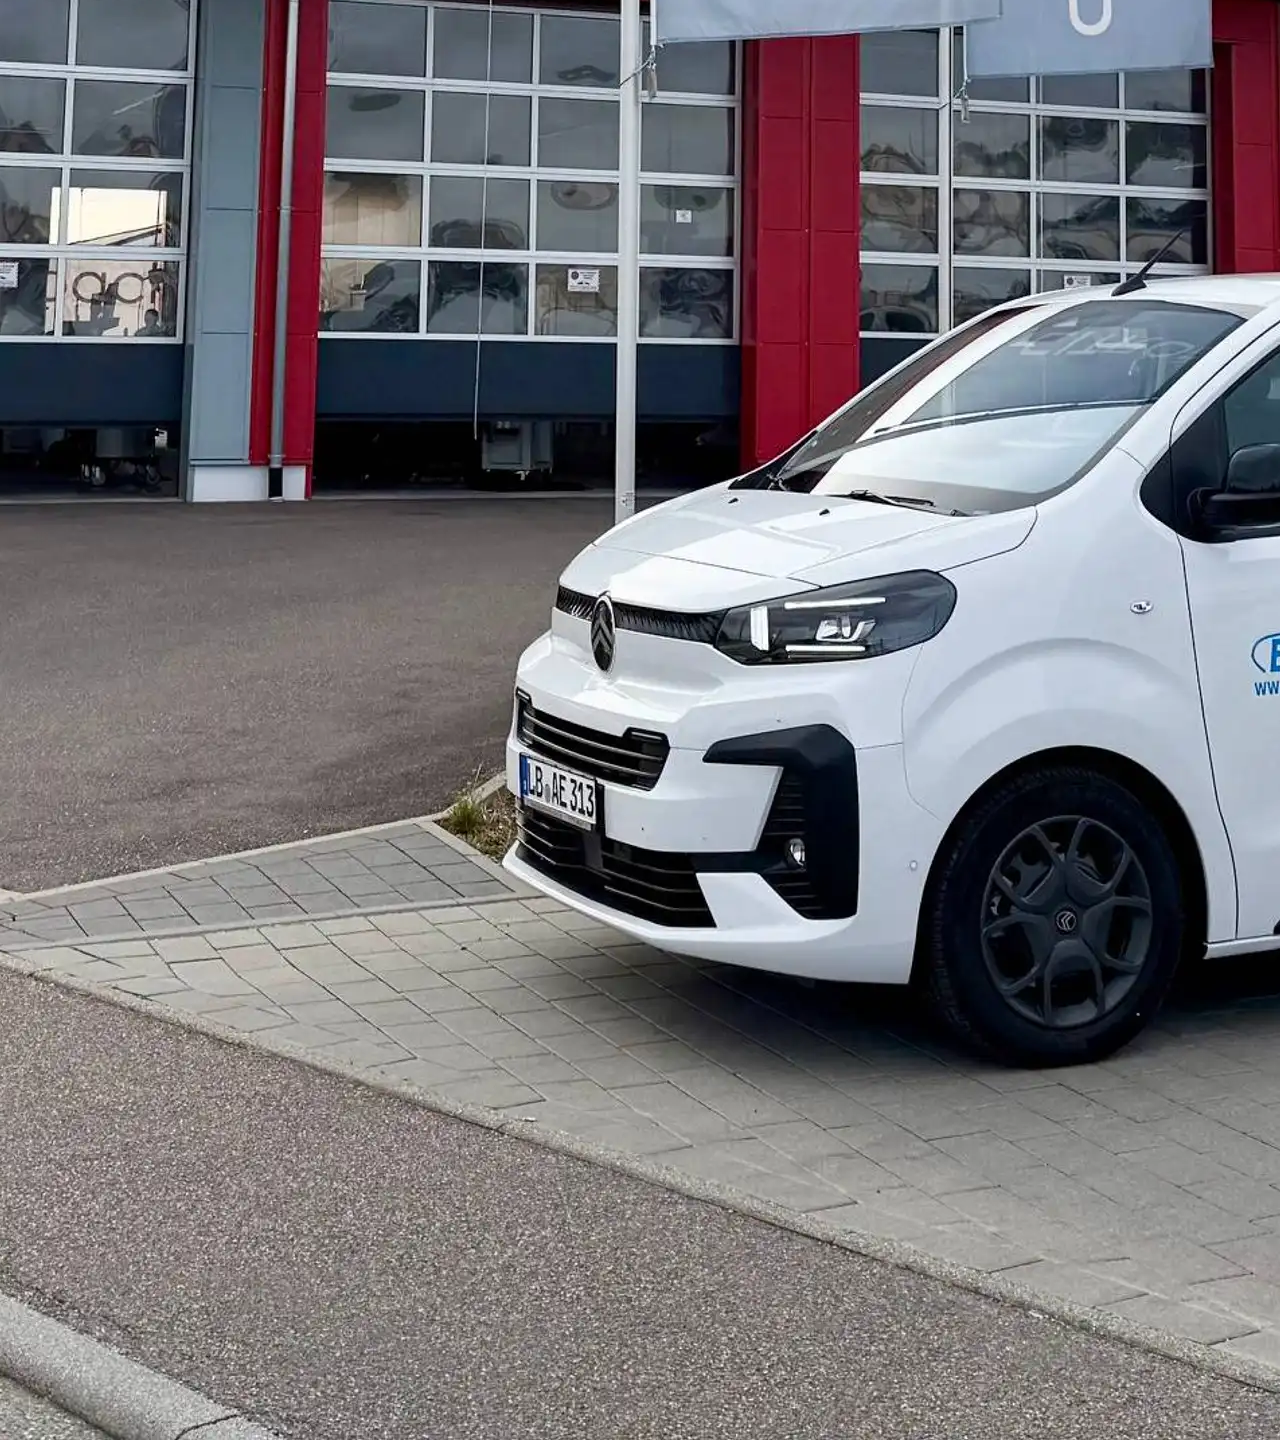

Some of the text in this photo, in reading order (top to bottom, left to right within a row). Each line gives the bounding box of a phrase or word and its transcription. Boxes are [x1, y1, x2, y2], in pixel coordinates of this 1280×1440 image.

[528, 762, 543, 798] LB
[551, 771, 568, 808] AE
[570, 778, 595, 818] 313
